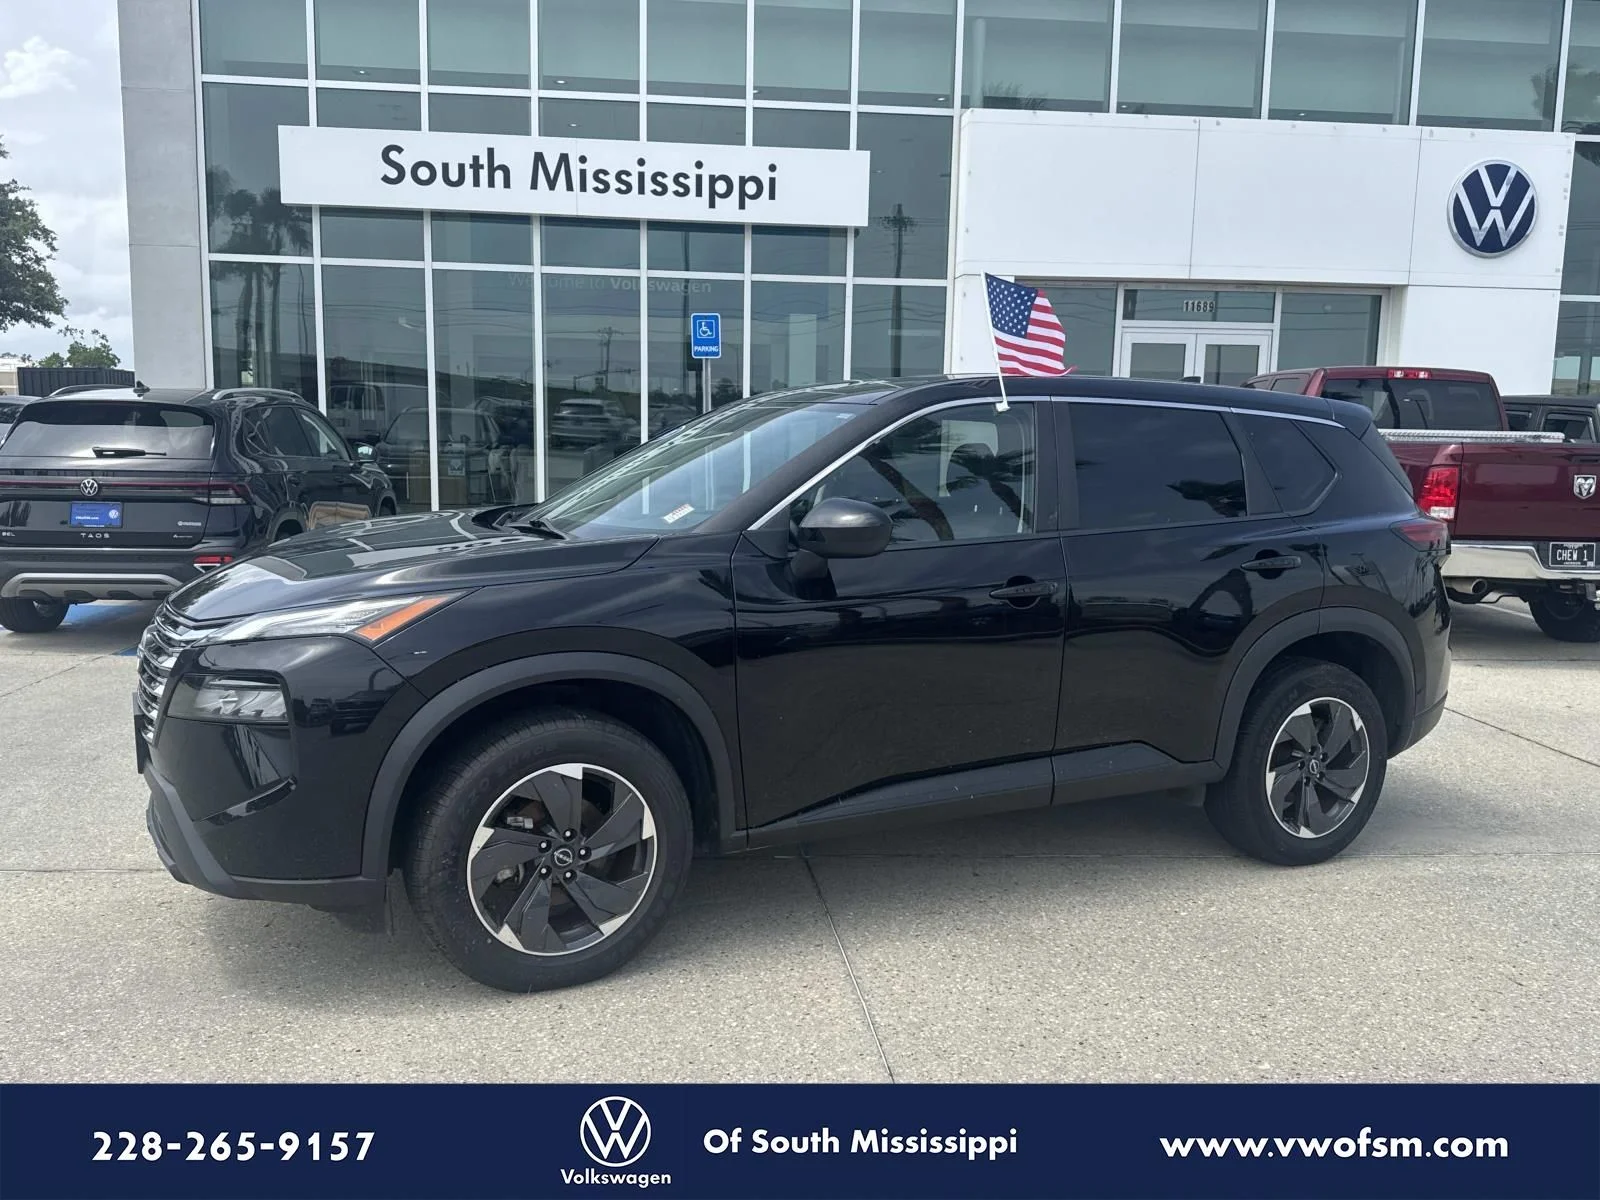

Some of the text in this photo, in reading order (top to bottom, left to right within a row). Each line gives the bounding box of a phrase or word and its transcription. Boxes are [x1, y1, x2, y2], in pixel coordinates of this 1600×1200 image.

[381, 144, 777, 209] South Mississippi
[1447, 159, 1538, 259] VW
[508, 273, 584, 289] Weome
[610, 276, 712, 295] Volswagen
[1184, 300, 1215, 313] 11689
[1583, 549, 1588, 561] 1
